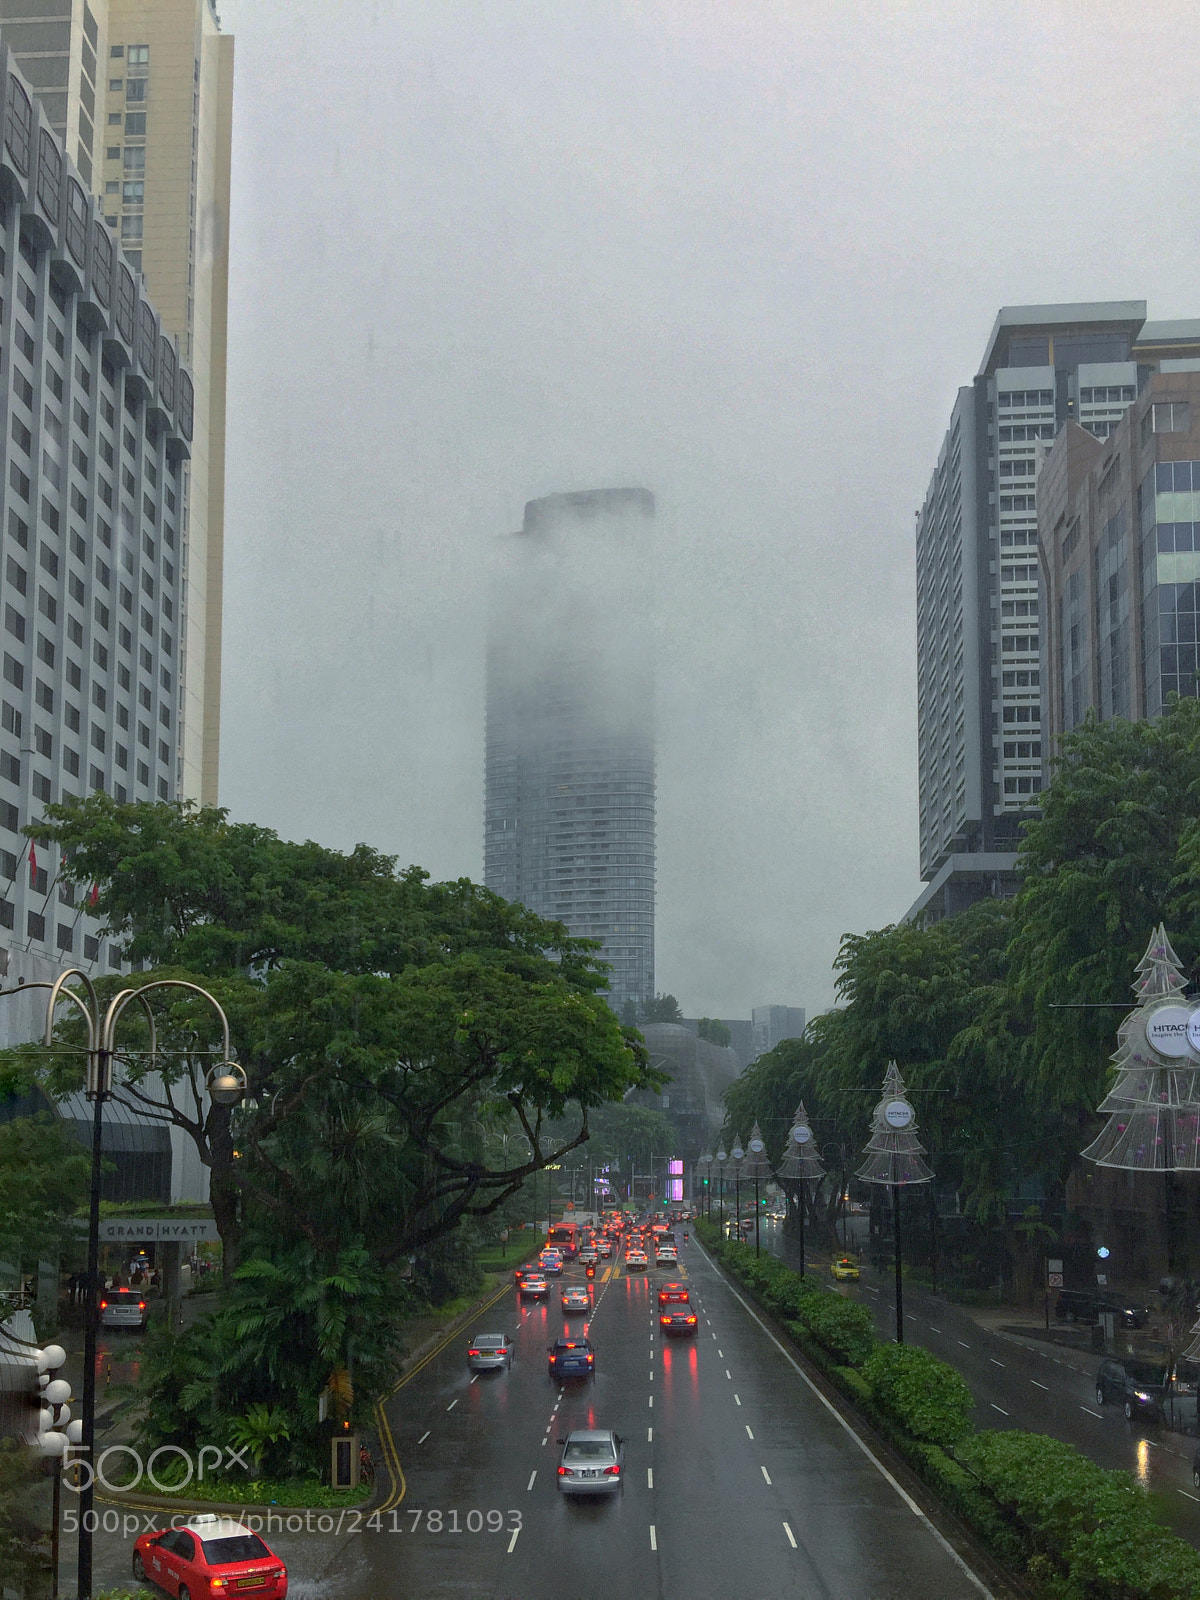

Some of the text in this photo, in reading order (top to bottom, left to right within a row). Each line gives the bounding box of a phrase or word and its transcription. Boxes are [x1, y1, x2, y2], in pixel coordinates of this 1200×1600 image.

[1153, 1024, 1188, 1032] HITAC
[107, 1225, 207, 1236] GRAND HYATT
